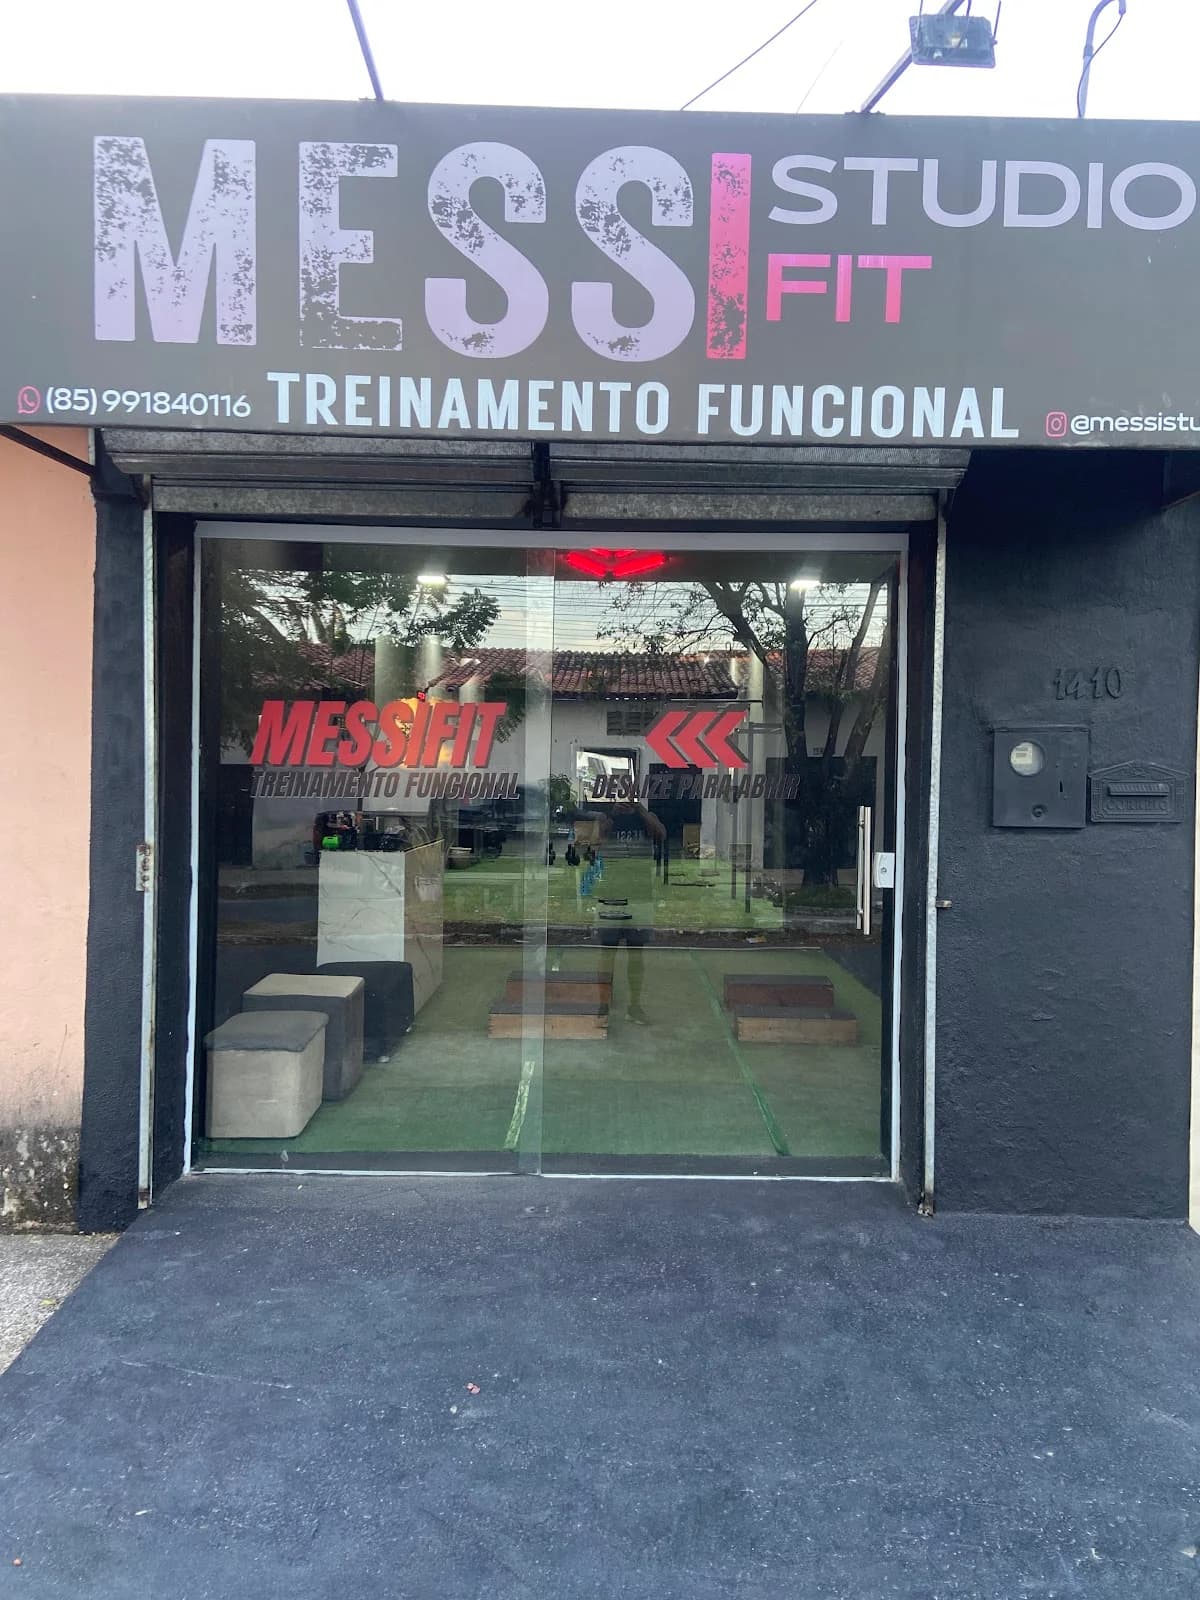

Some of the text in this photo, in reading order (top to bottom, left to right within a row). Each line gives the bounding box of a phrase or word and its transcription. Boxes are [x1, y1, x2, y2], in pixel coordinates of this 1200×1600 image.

[94, 136, 1197, 362] MESSI STUDIO
[766, 254, 932, 323] FIT
[267, 372, 1019, 439] TREINAMENTO FUNCIONAL
[250, 770, 400, 800] TREINAMENTO
